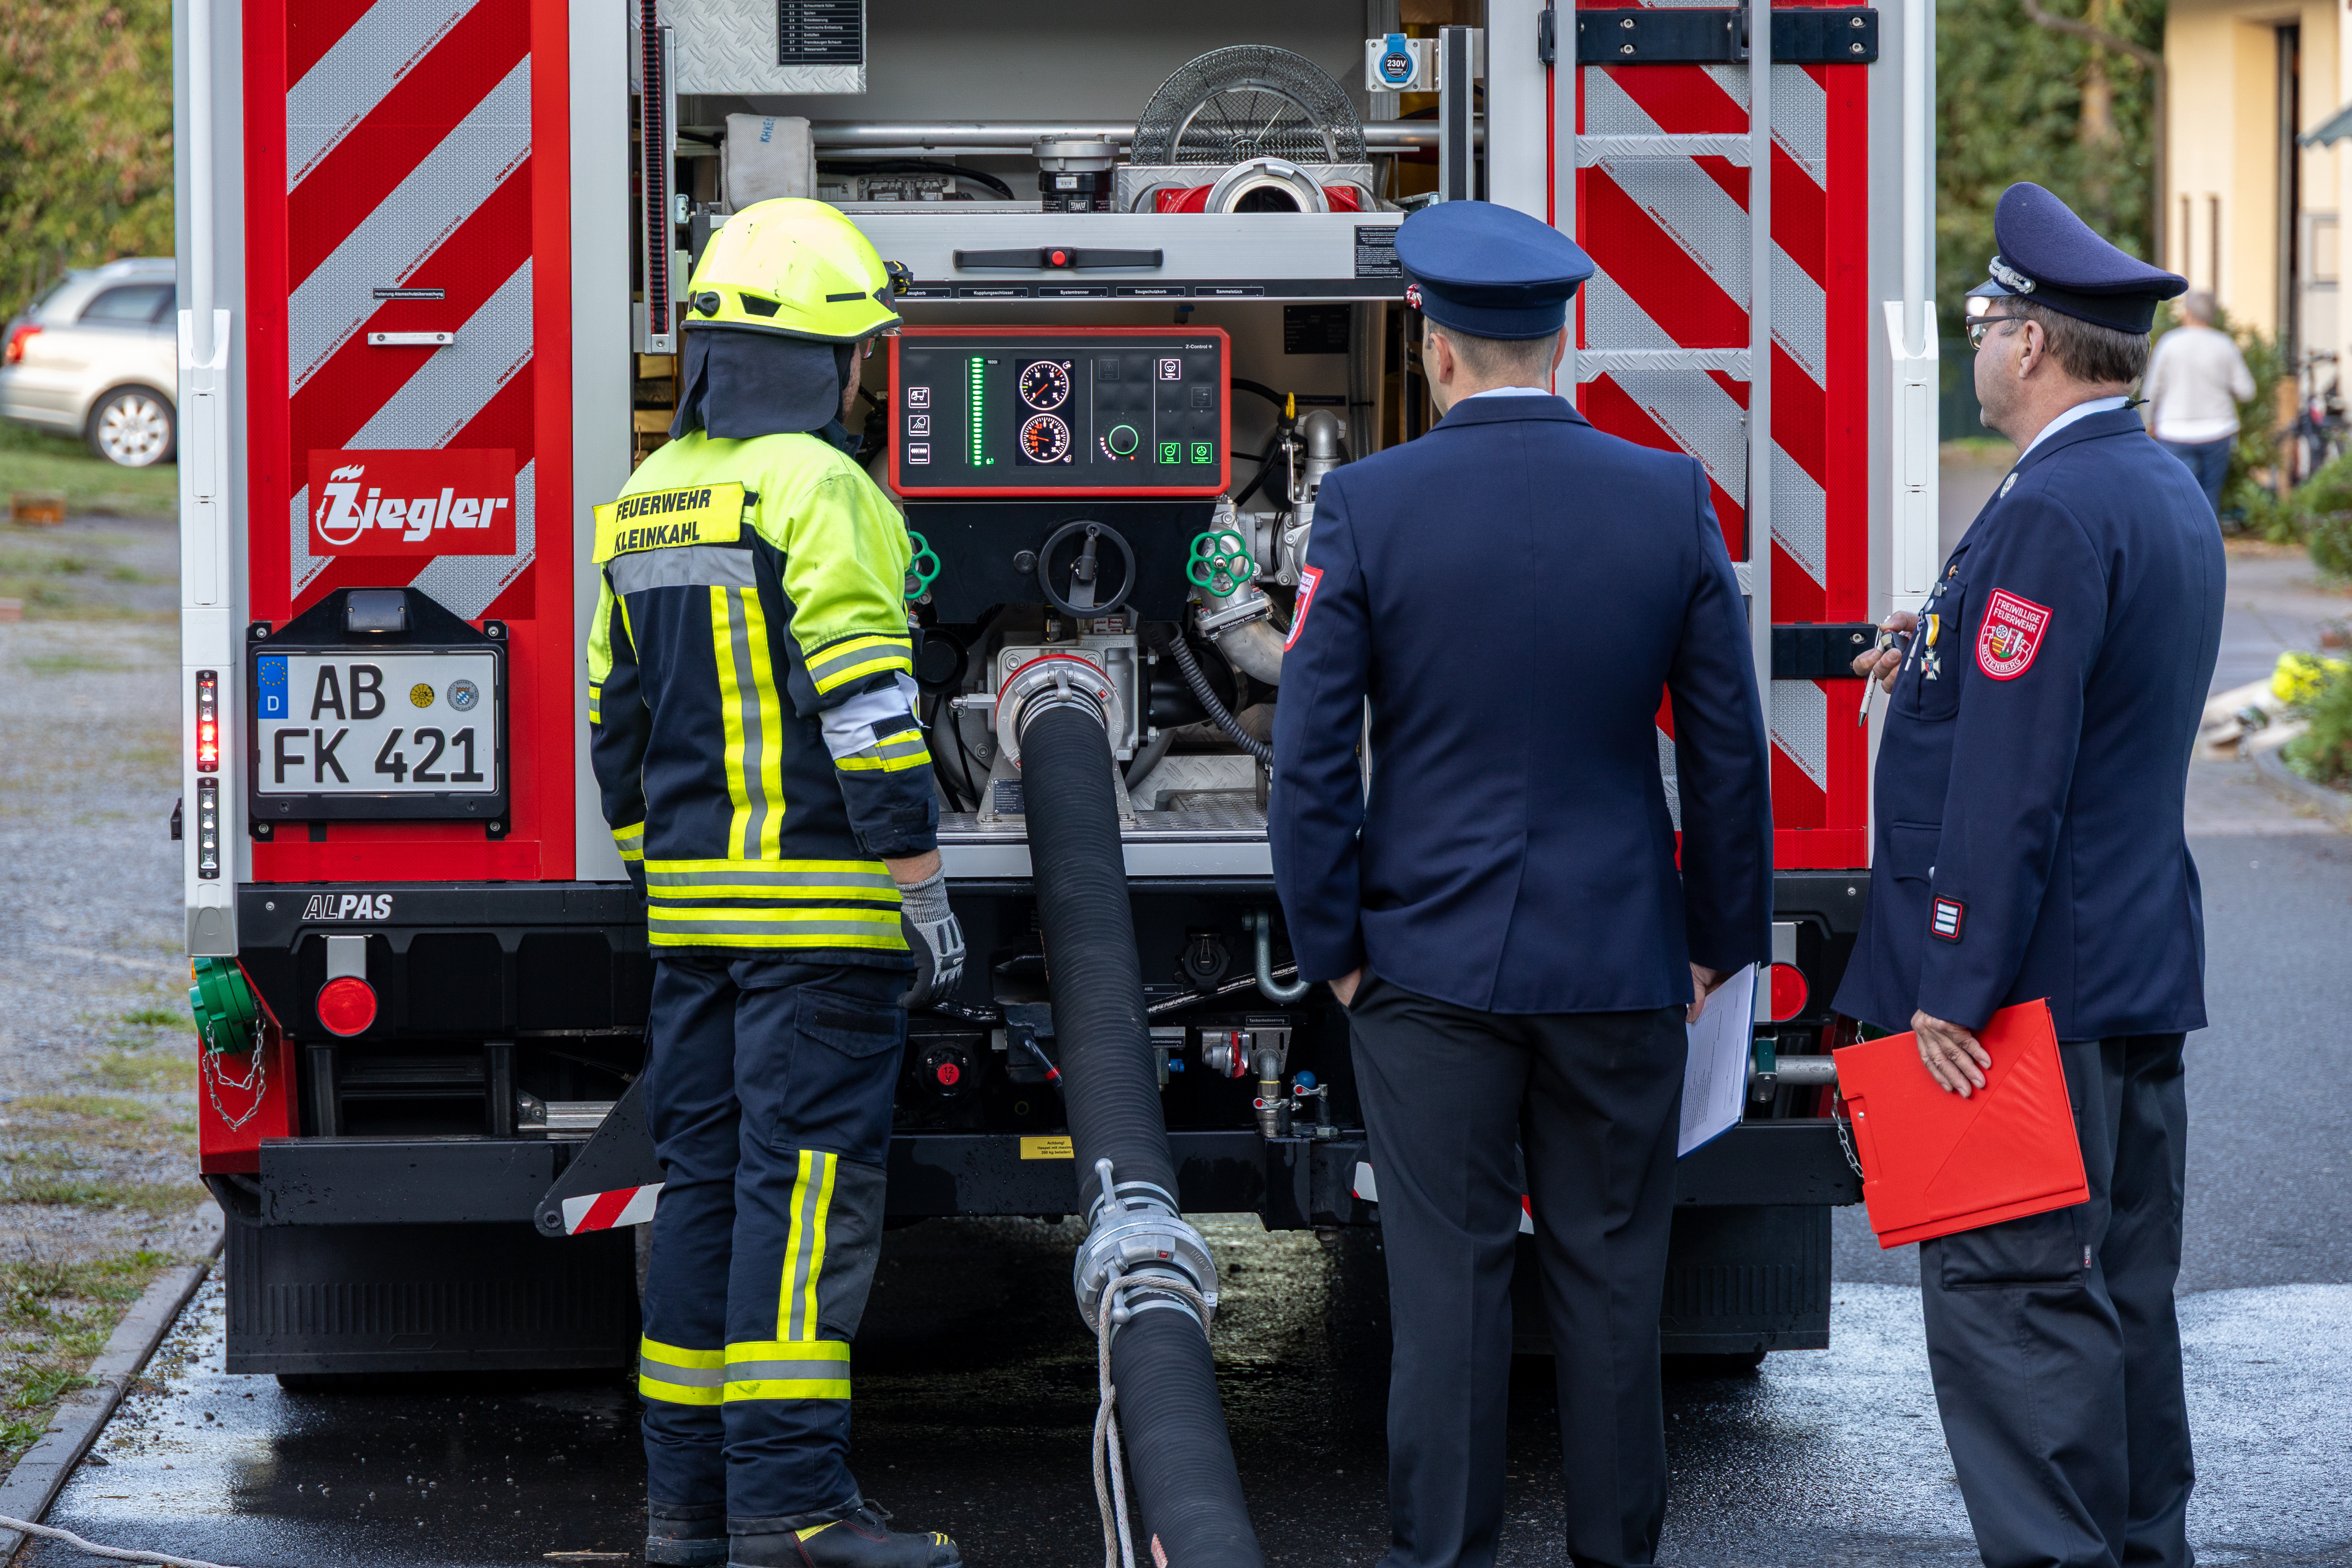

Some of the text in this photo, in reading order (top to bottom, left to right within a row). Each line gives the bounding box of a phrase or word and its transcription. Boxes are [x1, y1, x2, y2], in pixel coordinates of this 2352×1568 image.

[495, 161, 514, 181] ORALITE
[1647, 205, 1667, 225] ORALITE
[394, 263, 414, 283] ORALITE
[294, 365, 314, 385] ORALITE
[496, 364, 516, 384] ORALITE
[1648, 406, 1668, 426] ORALITE
[316, 481, 508, 545] Ziegler
[616, 489, 711, 523] FEUERWEHR
[615, 521, 700, 553] KLEINKAHL
[296, 568, 316, 588] ORALITE
[498, 567, 518, 587] ORALITE
[1993, 608, 2037, 633] FEUERWEHR
[1996, 598, 2041, 624] FREIWILLIGE
[1220, 618, 1245, 630] Druckabgang
[1982, 644, 2020, 670] ROTTENBERG
[310, 663, 385, 720] AB
[268, 696, 279, 711] D
[274, 727, 483, 783] FK 421
[302, 894, 392, 919] ALPAS
